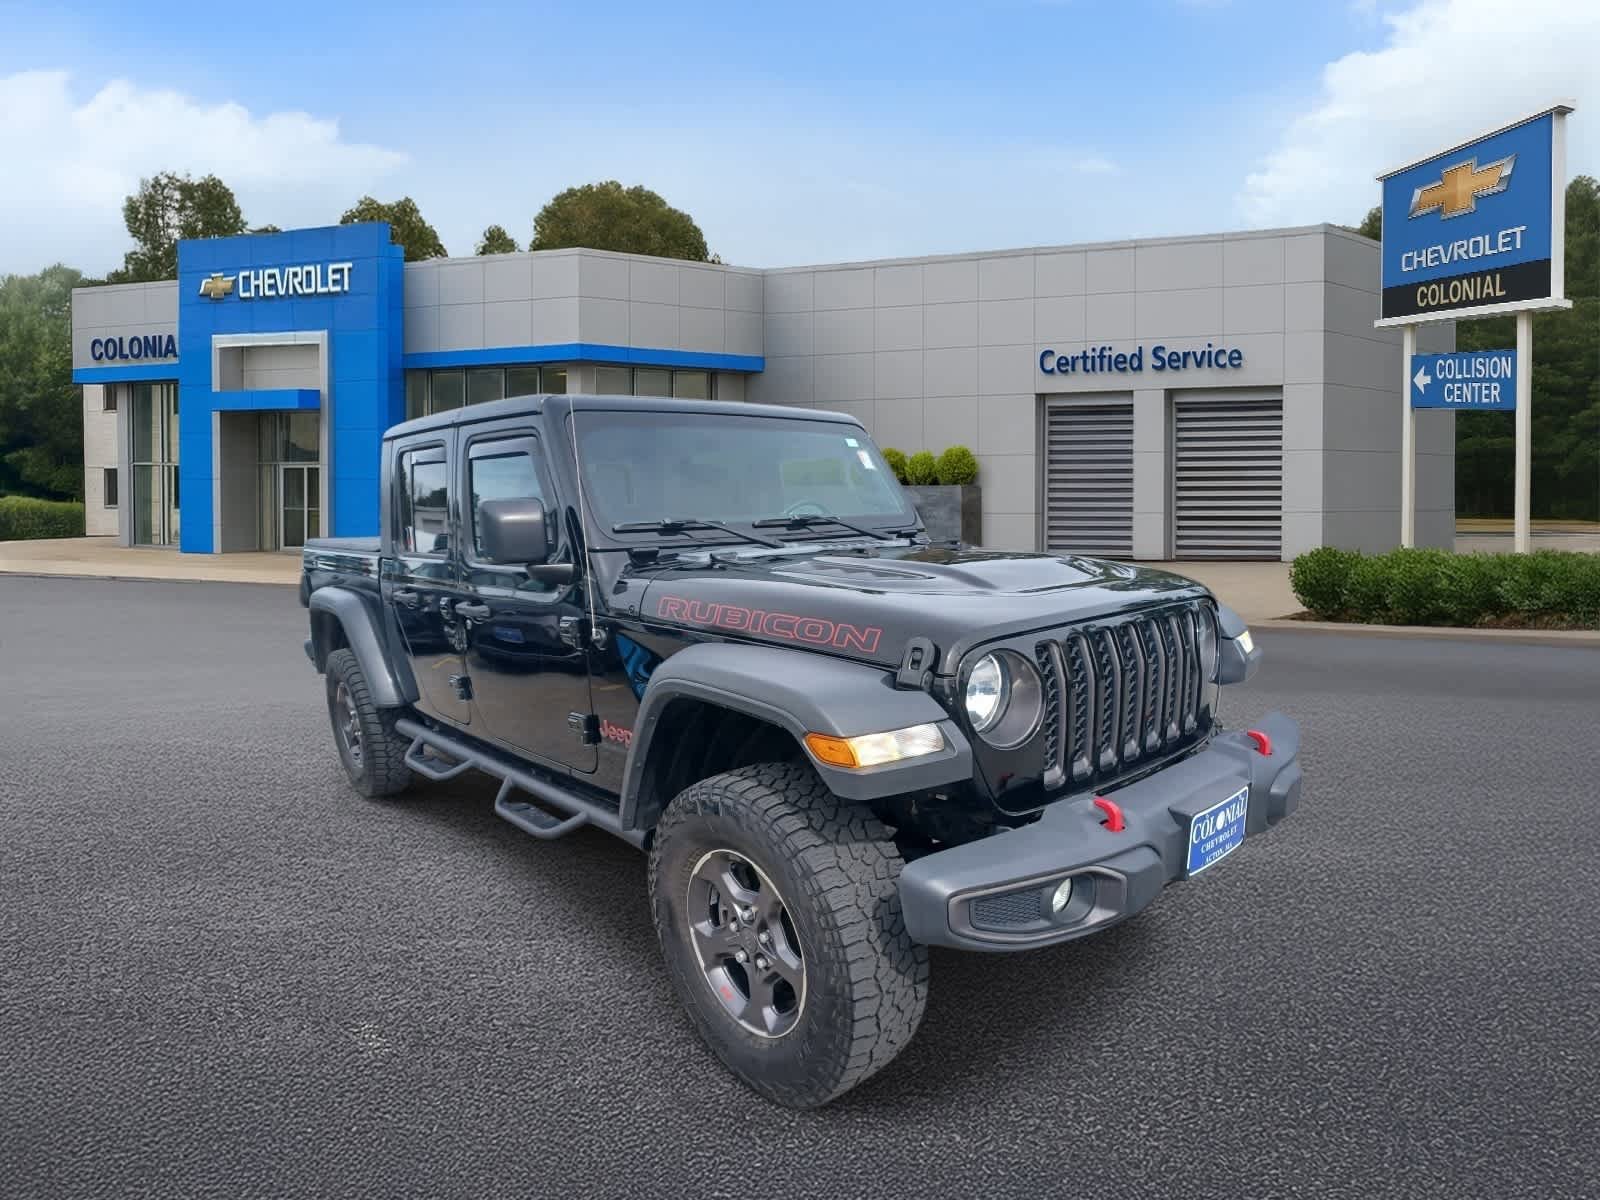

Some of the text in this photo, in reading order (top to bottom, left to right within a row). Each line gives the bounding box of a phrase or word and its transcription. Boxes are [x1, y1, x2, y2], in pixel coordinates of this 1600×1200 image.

[1401, 225, 1528, 272] CHEVROLET
[238, 262, 353, 298] CHEVROLET
[1416, 273, 1506, 307] COLONIAL
[1039, 343, 1244, 375] Certified Service
[1436, 356, 1512, 379] COLLISION
[1444, 382, 1501, 403] CENTER
[657, 596, 883, 652] RUBICON
[599, 719, 633, 745] Jeep
[1192, 796, 1246, 843] COLONIAL
[1201, 825, 1238, 853] CHEVROLET
